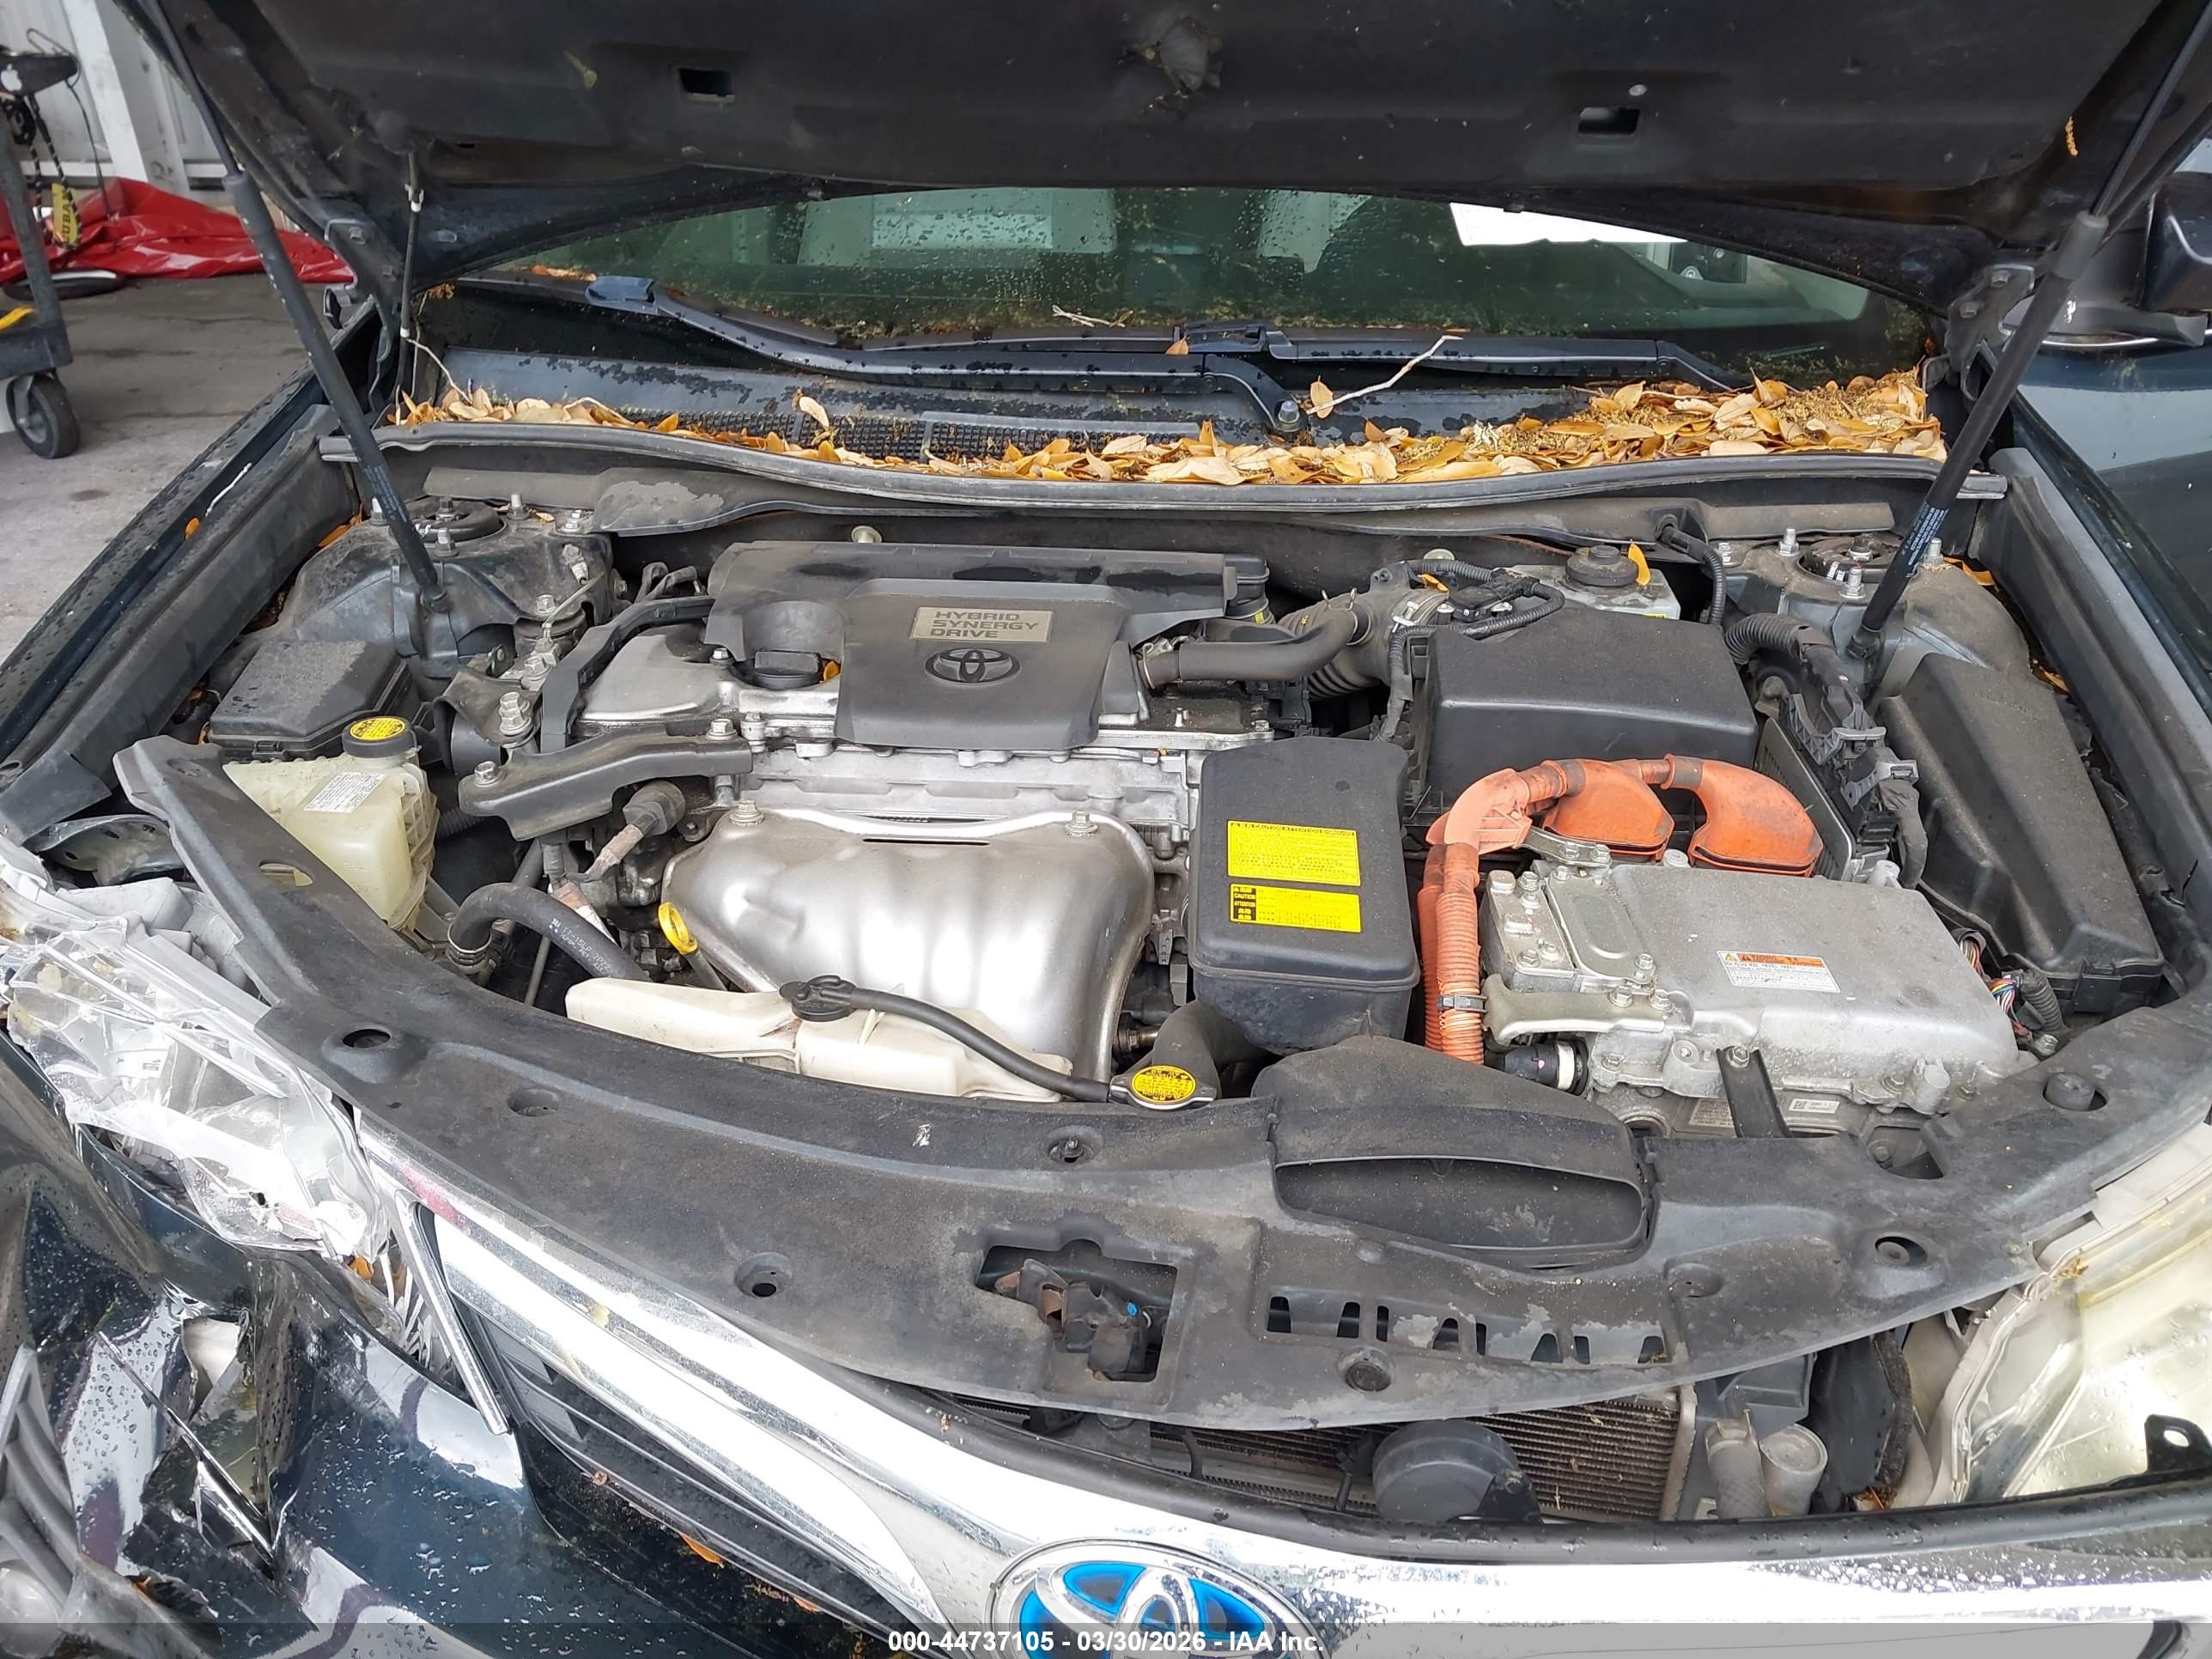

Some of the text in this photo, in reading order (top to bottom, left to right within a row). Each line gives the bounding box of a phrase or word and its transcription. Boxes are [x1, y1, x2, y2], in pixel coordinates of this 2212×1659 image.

[935, 611, 1020, 620] HYBRID
[933, 620, 1038, 629] SYNERGY
[930, 629, 999, 638] DRIVE
